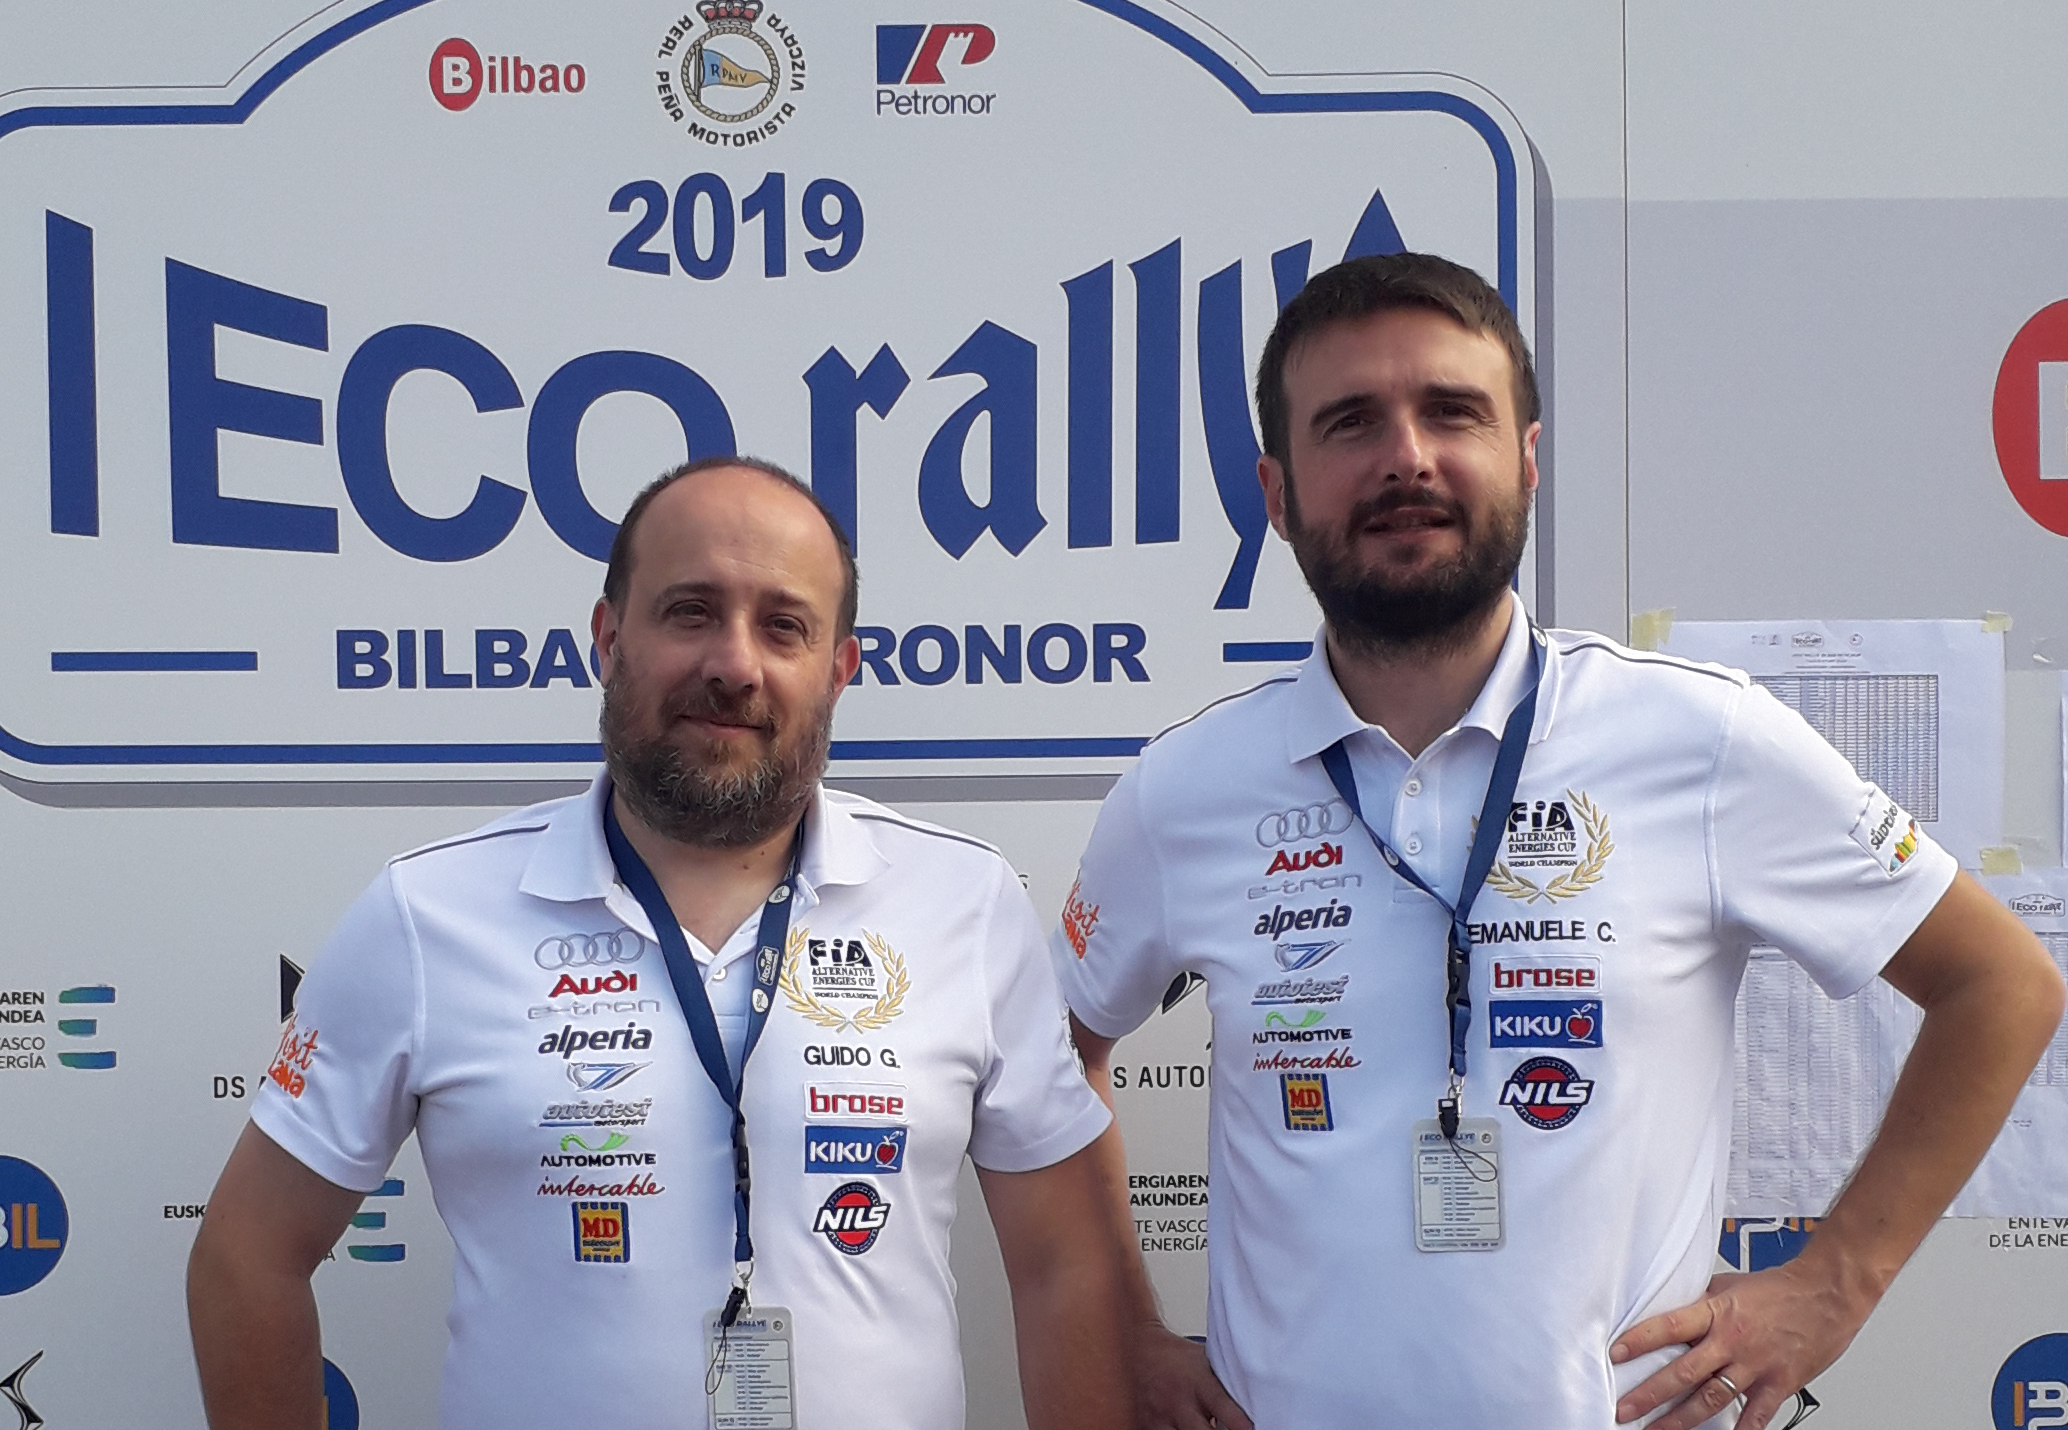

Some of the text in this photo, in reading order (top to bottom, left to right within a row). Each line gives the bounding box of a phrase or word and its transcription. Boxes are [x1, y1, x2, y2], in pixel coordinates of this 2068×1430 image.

[442, 55, 586, 94] Bilbao
[656, 13, 806, 147] REAL PEÑA MOTORISTA VIZCAYA
[876, 89, 997, 116] Petronor
[608, 171, 865, 280] 2019
[164, 256, 738, 564] ECO
[336, 622, 1151, 689] BILBA RONOR
[1507, 831, 1577, 843] ALTERNATIVE
[1508, 841, 1577, 854] ENERGIES CUP
[1264, 841, 1343, 877] Audi
[1253, 898, 1353, 942] alperia
[1467, 919, 1617, 945] EMANUELE C.
[547, 969, 638, 998] Audi
[811, 966, 875, 977] ALTERNATIVE
[812, 976, 876, 987] ENERGIES CUP
[1494, 962, 1596, 989] brose
[1252, 1028, 1353, 1045] AUTOMOTIVE
[1494, 1015, 1562, 1037] KIKU
[0, 1036, 46, 1051] ASCO
[537, 1021, 653, 1060] alperia
[803, 1045, 902, 1069] GUIDO G.
[1252, 1046, 1363, 1072] intercable
[213, 1075, 246, 1099] DS
[1113, 1065, 1211, 1089] S AUTO
[809, 1086, 904, 1116] brose
[1288, 1088, 1322, 1109] MD
[1503, 1081, 1591, 1105] NILS
[540, 1152, 657, 1168] AUTOMOTIVE
[808, 1141, 873, 1163] KIKU
[536, 1171, 666, 1197] intercable
[1128, 1174, 1208, 1189] ERGIAREN
[164, 1204, 206, 1219] EUSK
[1129, 1192, 1209, 1207] AKUNDEA
[581, 1217, 620, 1239] MD
[817, 1204, 888, 1231] NILS
[1135, 1219, 1153, 1234] TE
[1989, 1233, 2011, 1248] DE
[2014, 1233, 2034, 1248] LA
